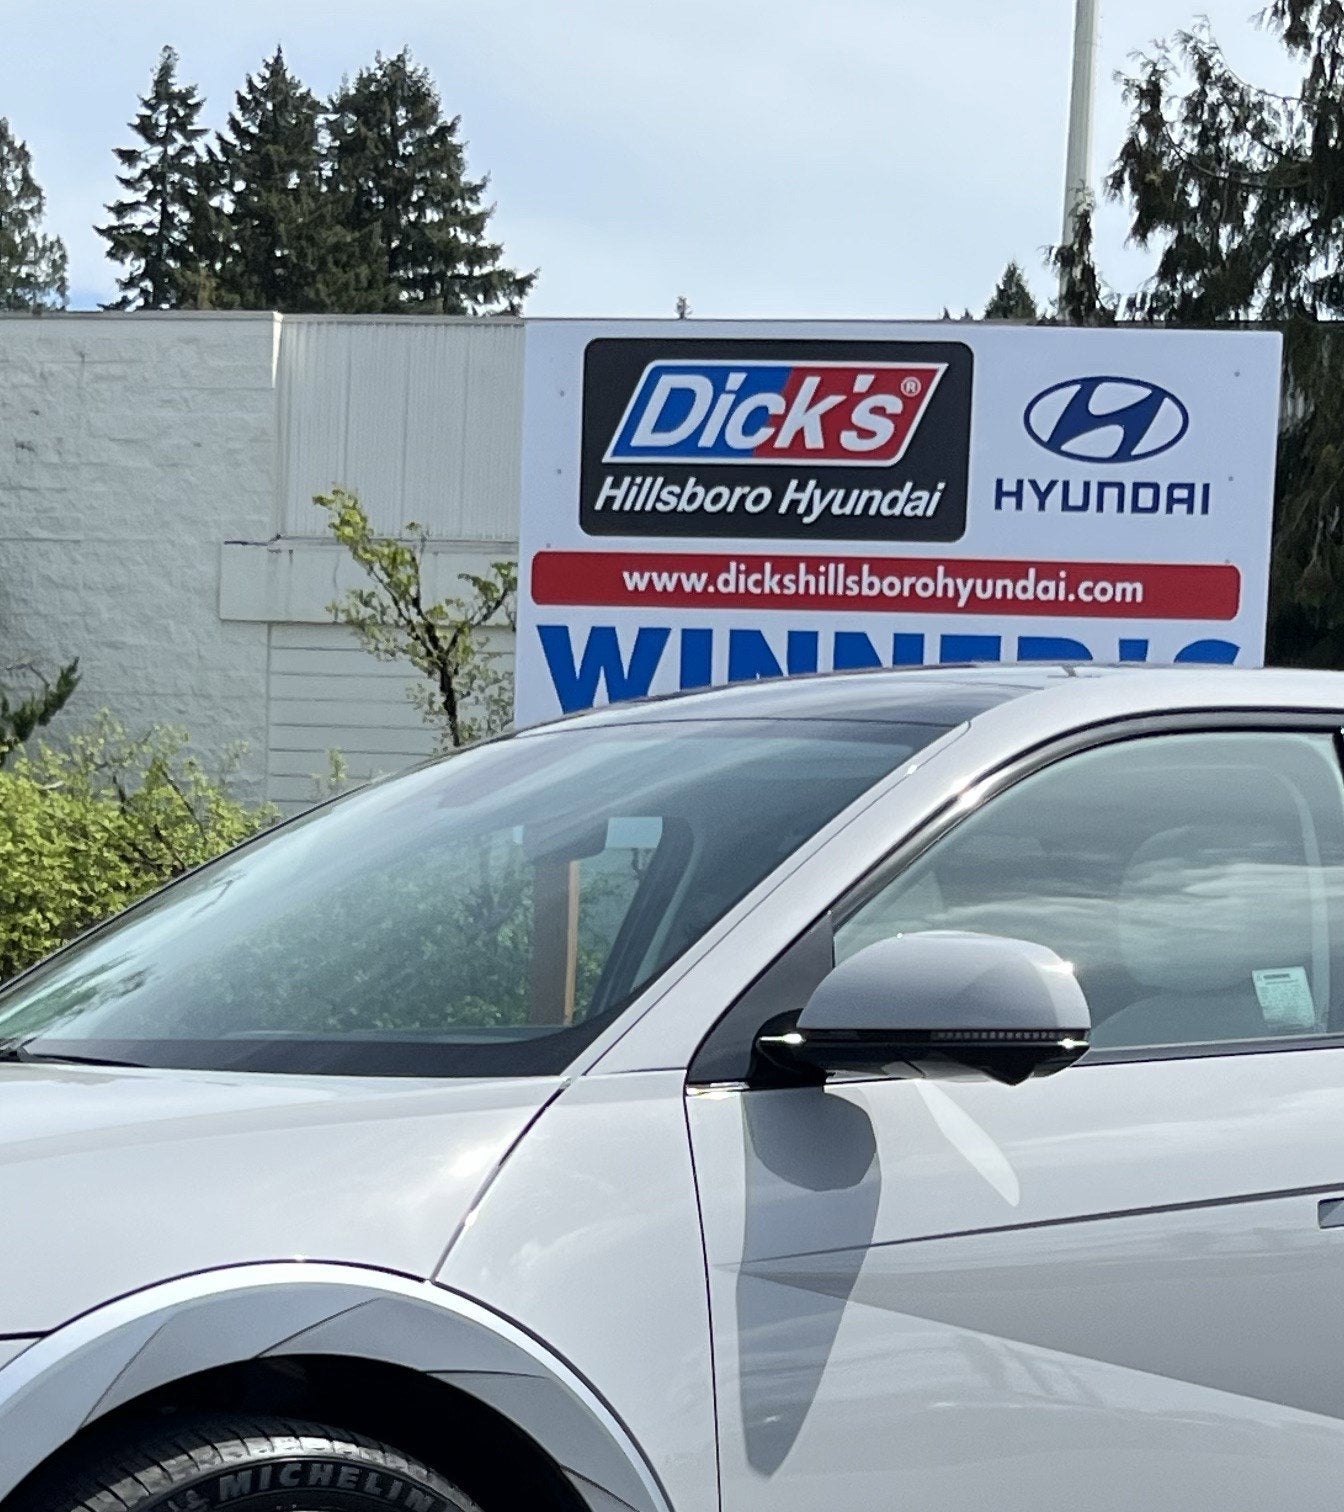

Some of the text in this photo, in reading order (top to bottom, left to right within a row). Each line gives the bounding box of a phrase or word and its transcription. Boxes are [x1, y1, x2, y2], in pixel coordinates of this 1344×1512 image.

[594, 476, 946, 524] Hillsboro Hyundai
[994, 477, 1211, 516] HYUNDAI
[622, 561, 1144, 608] www.dickshillsborohyundai.com
